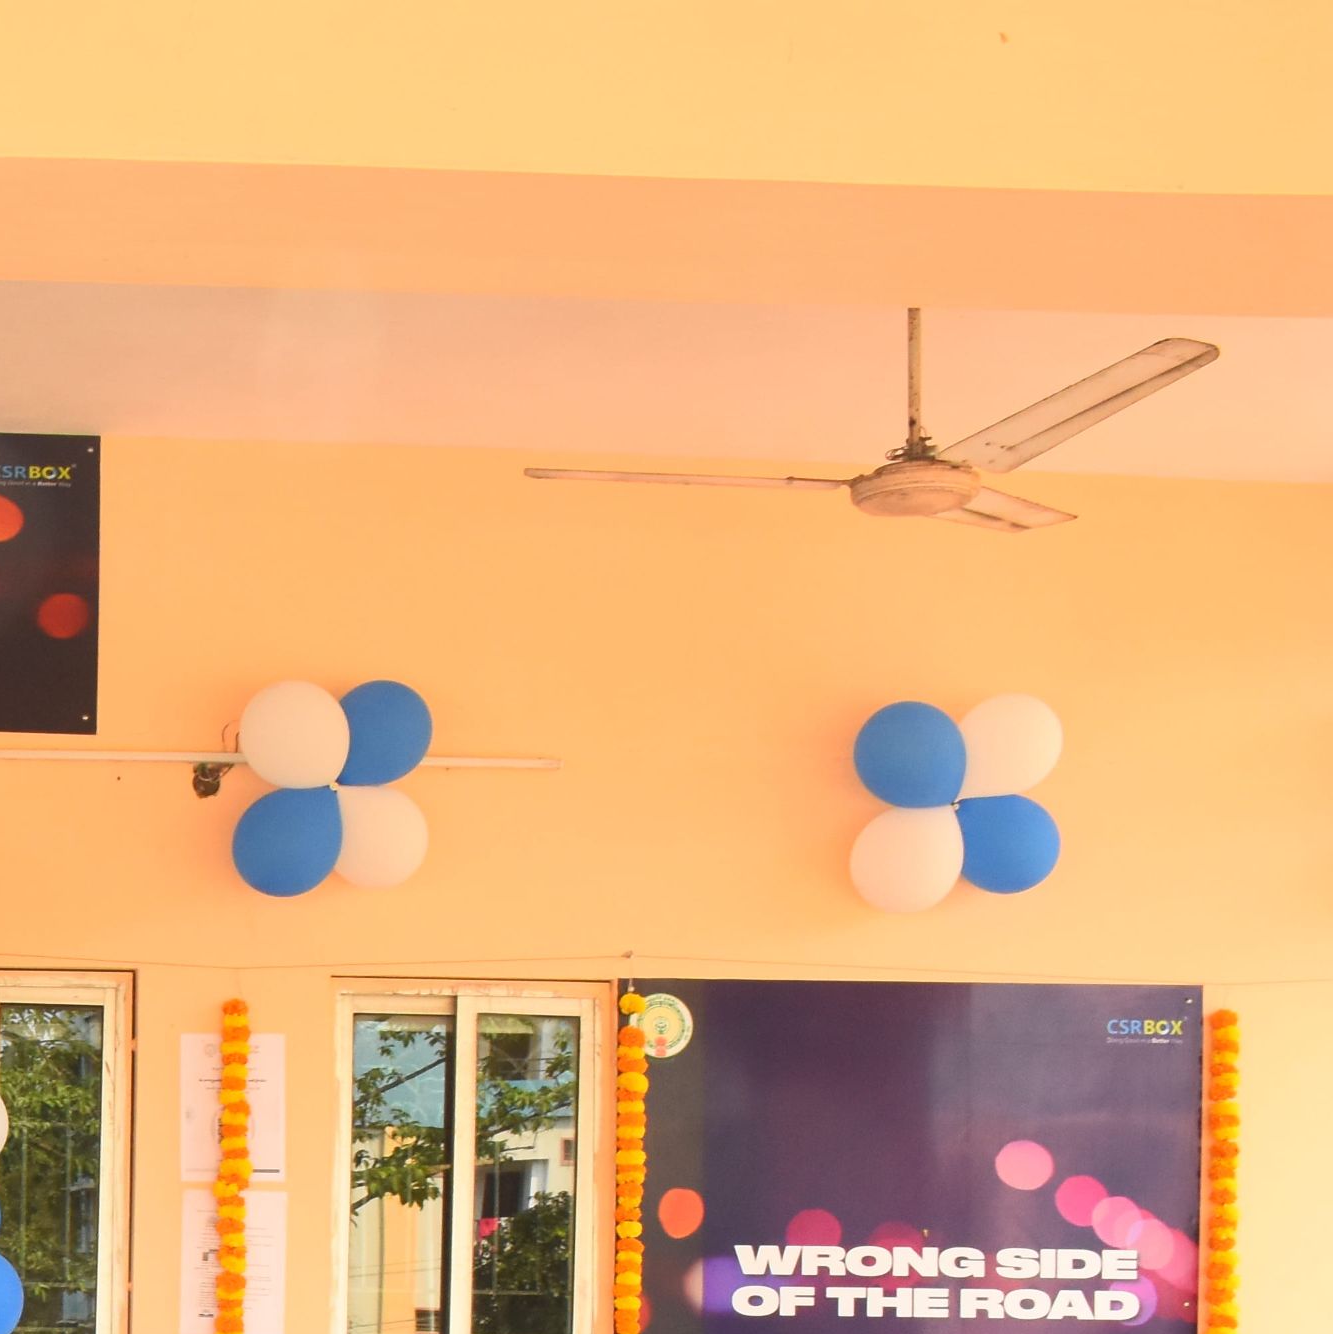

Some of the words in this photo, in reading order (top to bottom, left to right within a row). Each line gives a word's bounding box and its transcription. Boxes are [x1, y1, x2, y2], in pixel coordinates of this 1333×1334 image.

[1107, 1019, 1183, 1035] CSRBOX
[734, 1244, 985, 1277] WRONG
[996, 1247, 1139, 1280] SIDE
[732, 1285, 815, 1317] OF
[826, 1286, 949, 1318] THE
[960, 1288, 1140, 1321] ROAD
